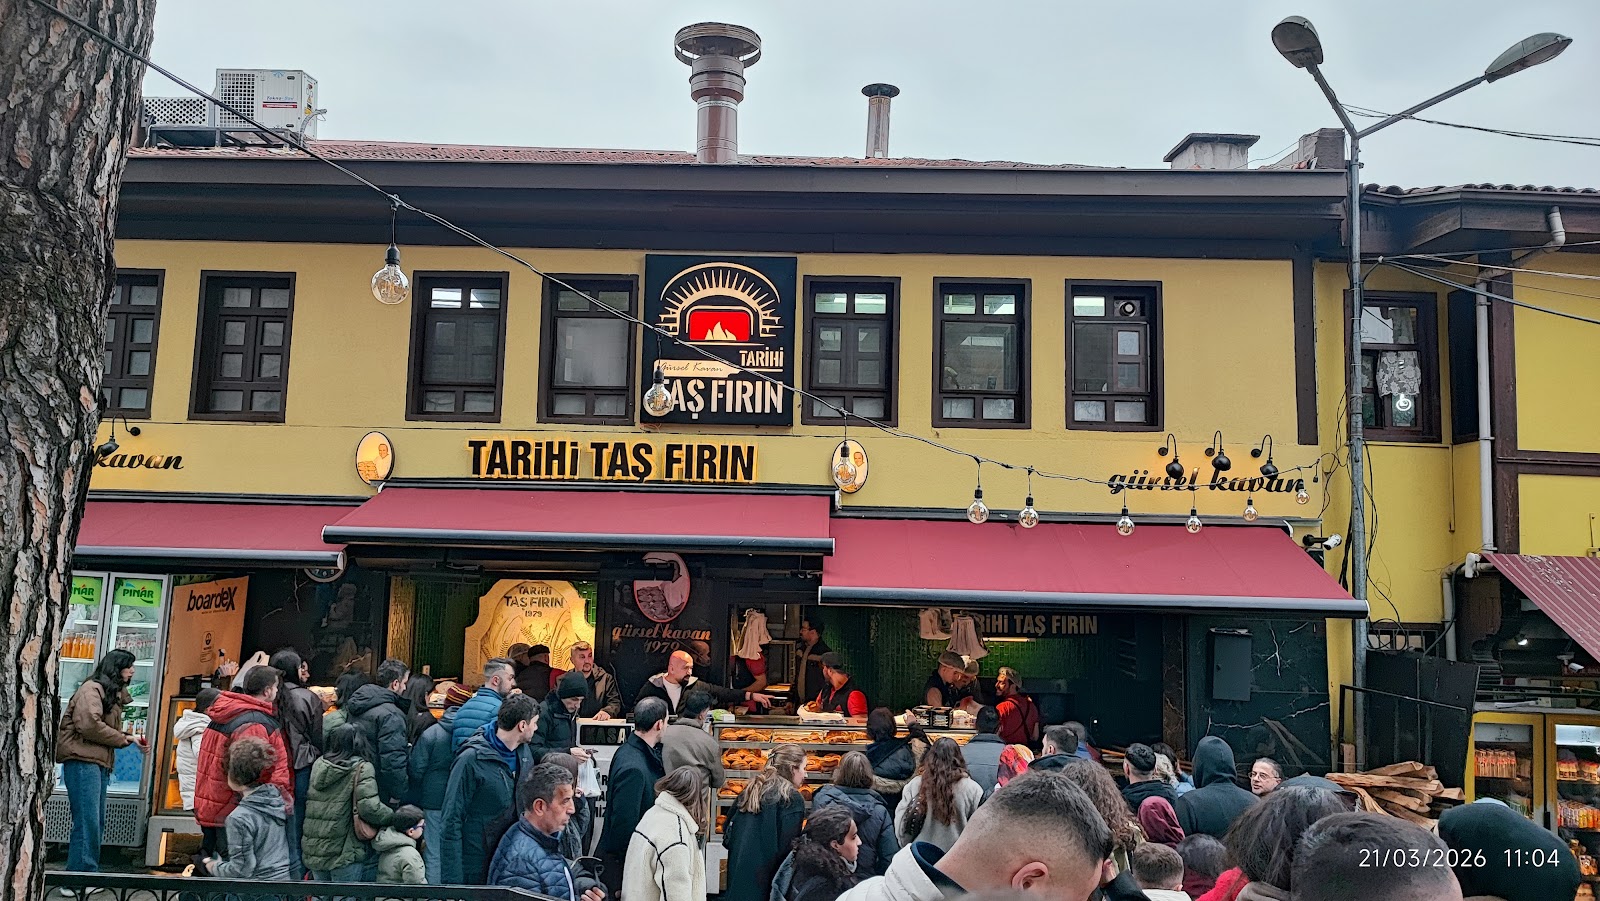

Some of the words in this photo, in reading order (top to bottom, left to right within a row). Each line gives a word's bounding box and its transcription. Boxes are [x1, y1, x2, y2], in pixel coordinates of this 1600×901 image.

[692, 361, 724, 373] Kavan
[661, 378, 706, 420] AŞ
[710, 380, 784, 414] FIRIN
[590, 442, 653, 483] TAŞ
[664, 444, 755, 481] FIRIN
[1107, 467, 1200, 494] gürsel
[1208, 467, 1304, 493] kavan
[72, 584, 95, 597] NAR
[504, 595, 528, 610] TAŞ
[530, 597, 564, 608] FIRIN
[612, 624, 659, 641] gürsel
[662, 624, 711, 641] kavan
[1013, 614, 1047, 636] TAŞ
[1051, 615, 1098, 635] FIRIN
[644, 640, 680, 653] 1979
[584, 727, 627, 744] KASA
